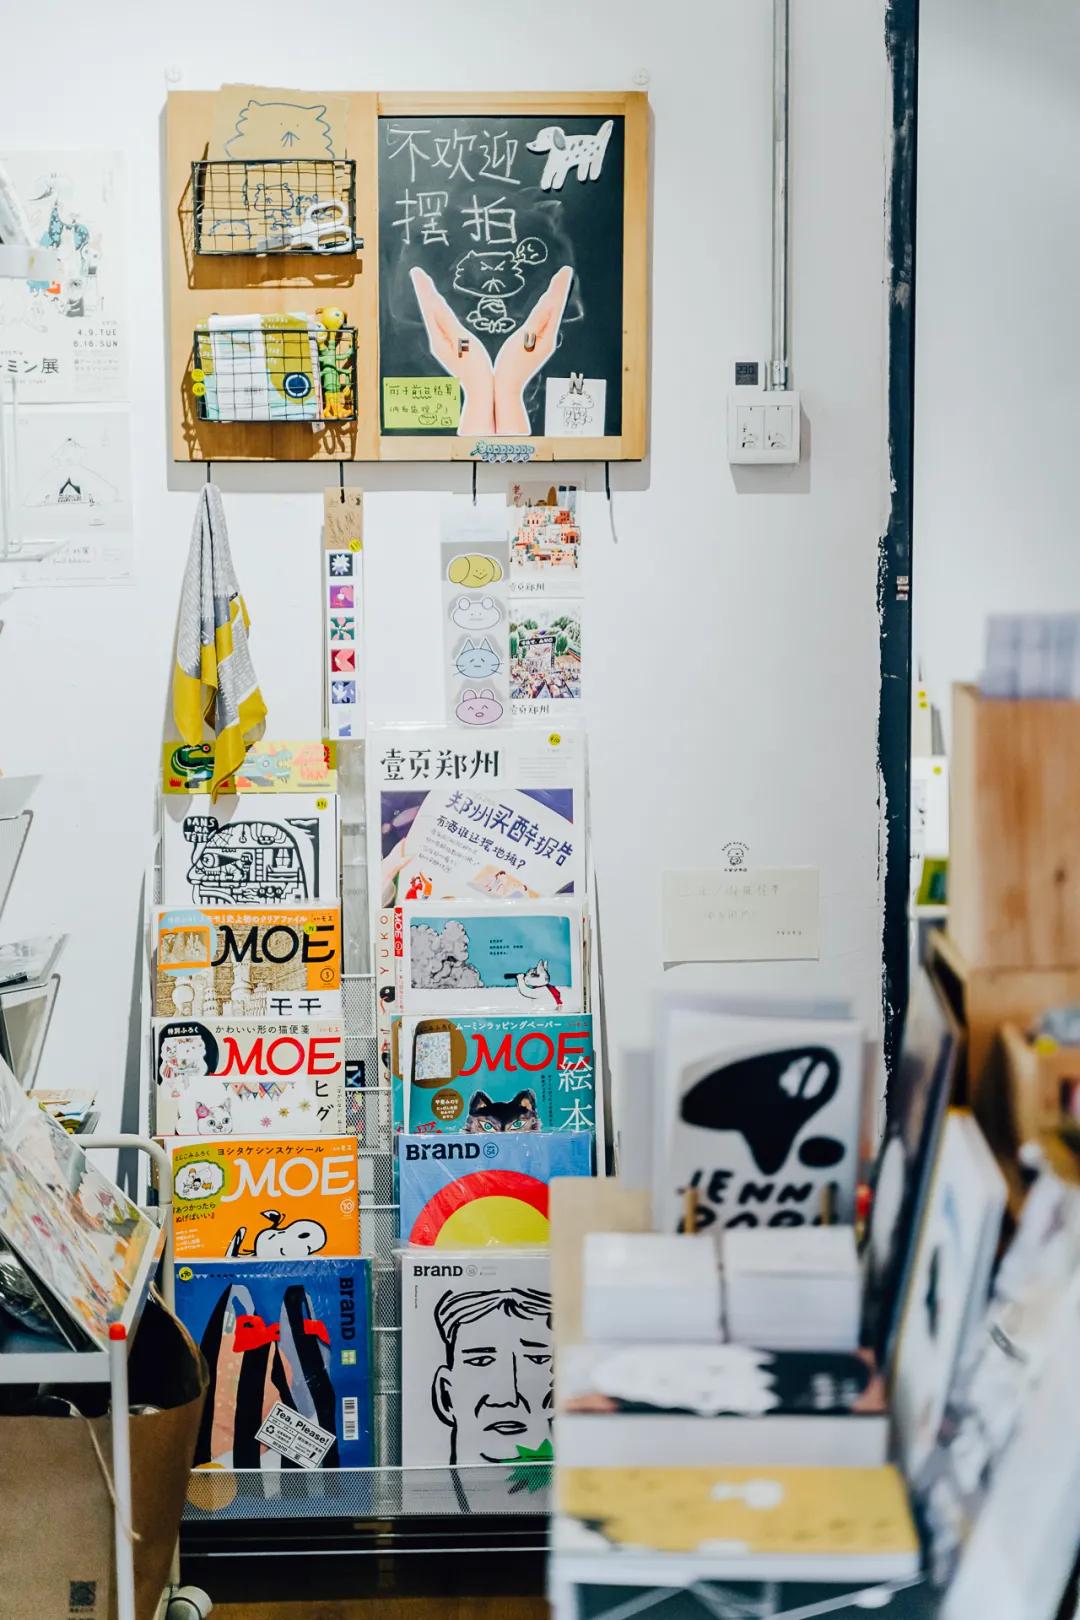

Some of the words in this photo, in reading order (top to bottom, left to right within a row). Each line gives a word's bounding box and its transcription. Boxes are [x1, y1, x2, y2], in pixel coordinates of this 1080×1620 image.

[389, 128, 520, 184] 不欢迎
[392, 189, 517, 246] 摆拍
[0, 357, 60, 374] ミン展
[570, 371, 584, 395] N
[380, 748, 500, 780] 壹页郑州
[446, 789, 574, 866] 郑州买醉报告
[211, 925, 335, 966] MOE
[215, 1025, 311, 1035] かわいい形の猫便箋
[456, 1020, 562, 1031] ムーミンラッピングペーパー
[208, 1037, 342, 1076] MOE
[459, 1032, 590, 1076] MOE
[315, 1079, 335, 1122] ヒグ
[558, 1056, 594, 1132] 絵本
[217, 1145, 324, 1156] ヨシタケシンスケシール
[220, 1155, 355, 1202] MOE
[275, 1407, 294, 1426] Tea,
[295, 1420, 330, 1446] Please!
